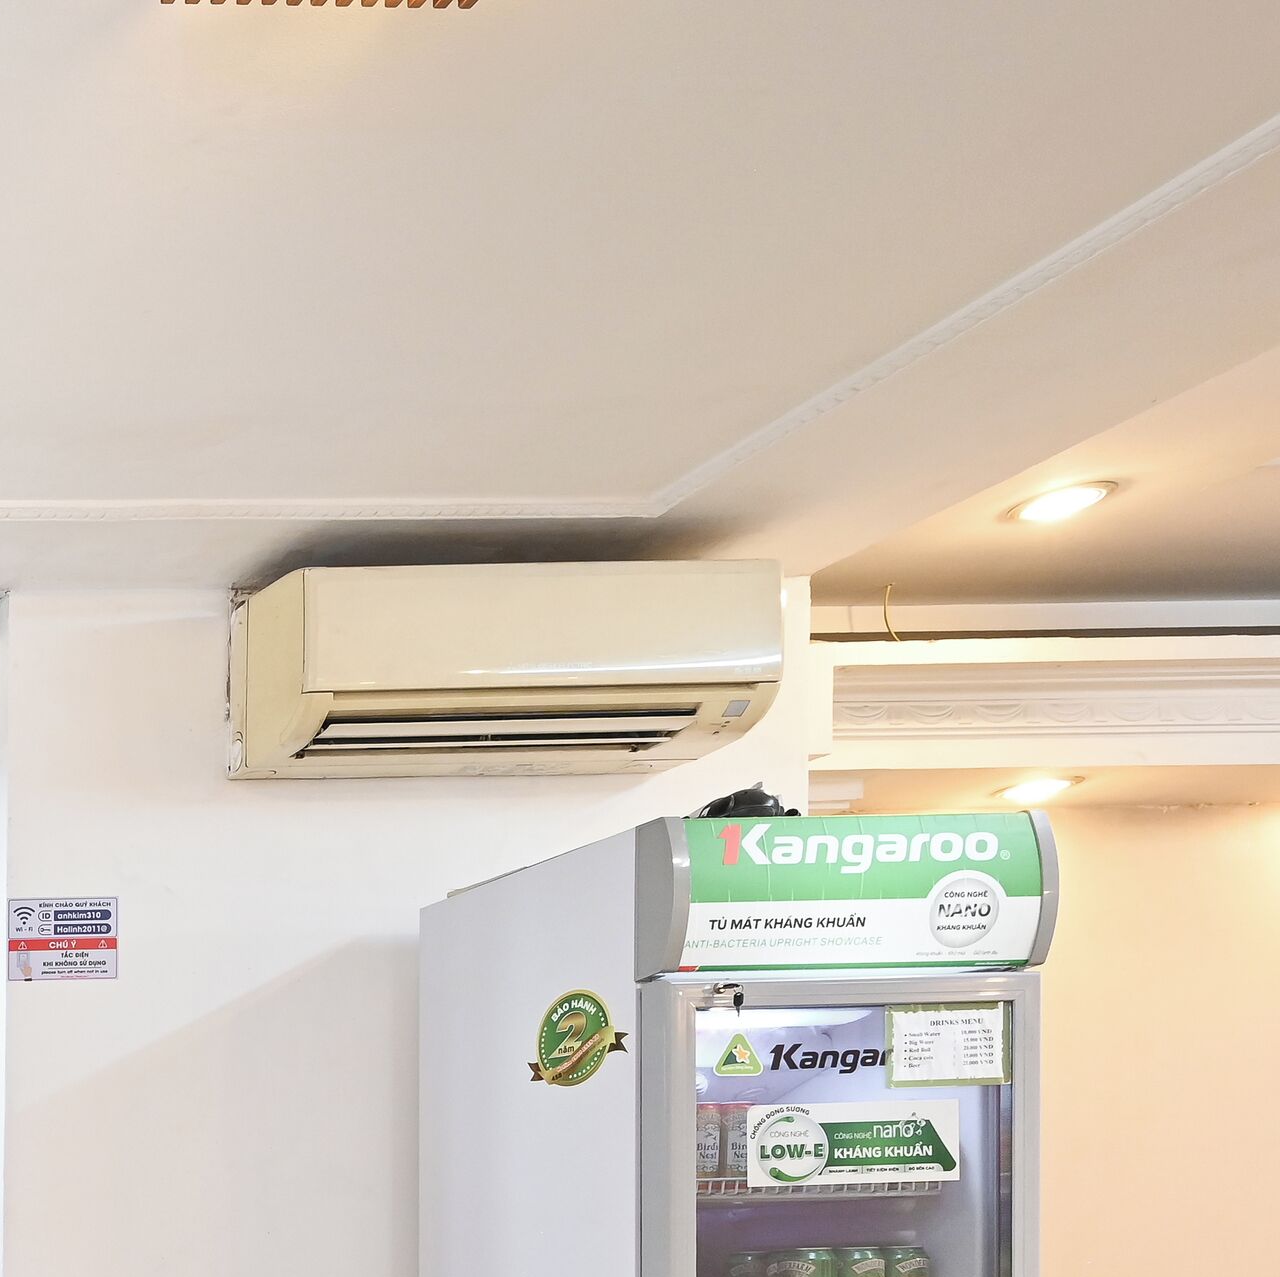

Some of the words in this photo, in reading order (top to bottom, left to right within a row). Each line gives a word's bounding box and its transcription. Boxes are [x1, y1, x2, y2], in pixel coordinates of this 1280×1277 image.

[717, 824, 998, 874] Kangaroo
[938, 903, 991, 917] NANO
[57, 925, 107, 933] Halinh2011@
[730, 916, 762, 930] MÁT
[764, 914, 813, 929] KHÁNG
[816, 912, 866, 928] KHUẨN
[49, 940, 68, 948] CHÚ
[71, 940, 76, 948] Ý
[685, 939, 767, 948] ANTI-BACTERIA
[769, 937, 818, 947] UPRIGHT
[821, 936, 883, 946] SHOWCASE
[551, 1003, 569, 1022] BẢO
[548, 1011, 587, 1059] 2
[558, 1046, 574, 1054] năm
[770, 1044, 893, 1074] Kangar
[834, 1132, 853, 1140] CÔNG
[873, 1124, 914, 1138] nano
[760, 1144, 825, 1159] LOW-E
[834, 1145, 881, 1158] KHÁNG
[885, 1142, 932, 1157] KHUẨN
